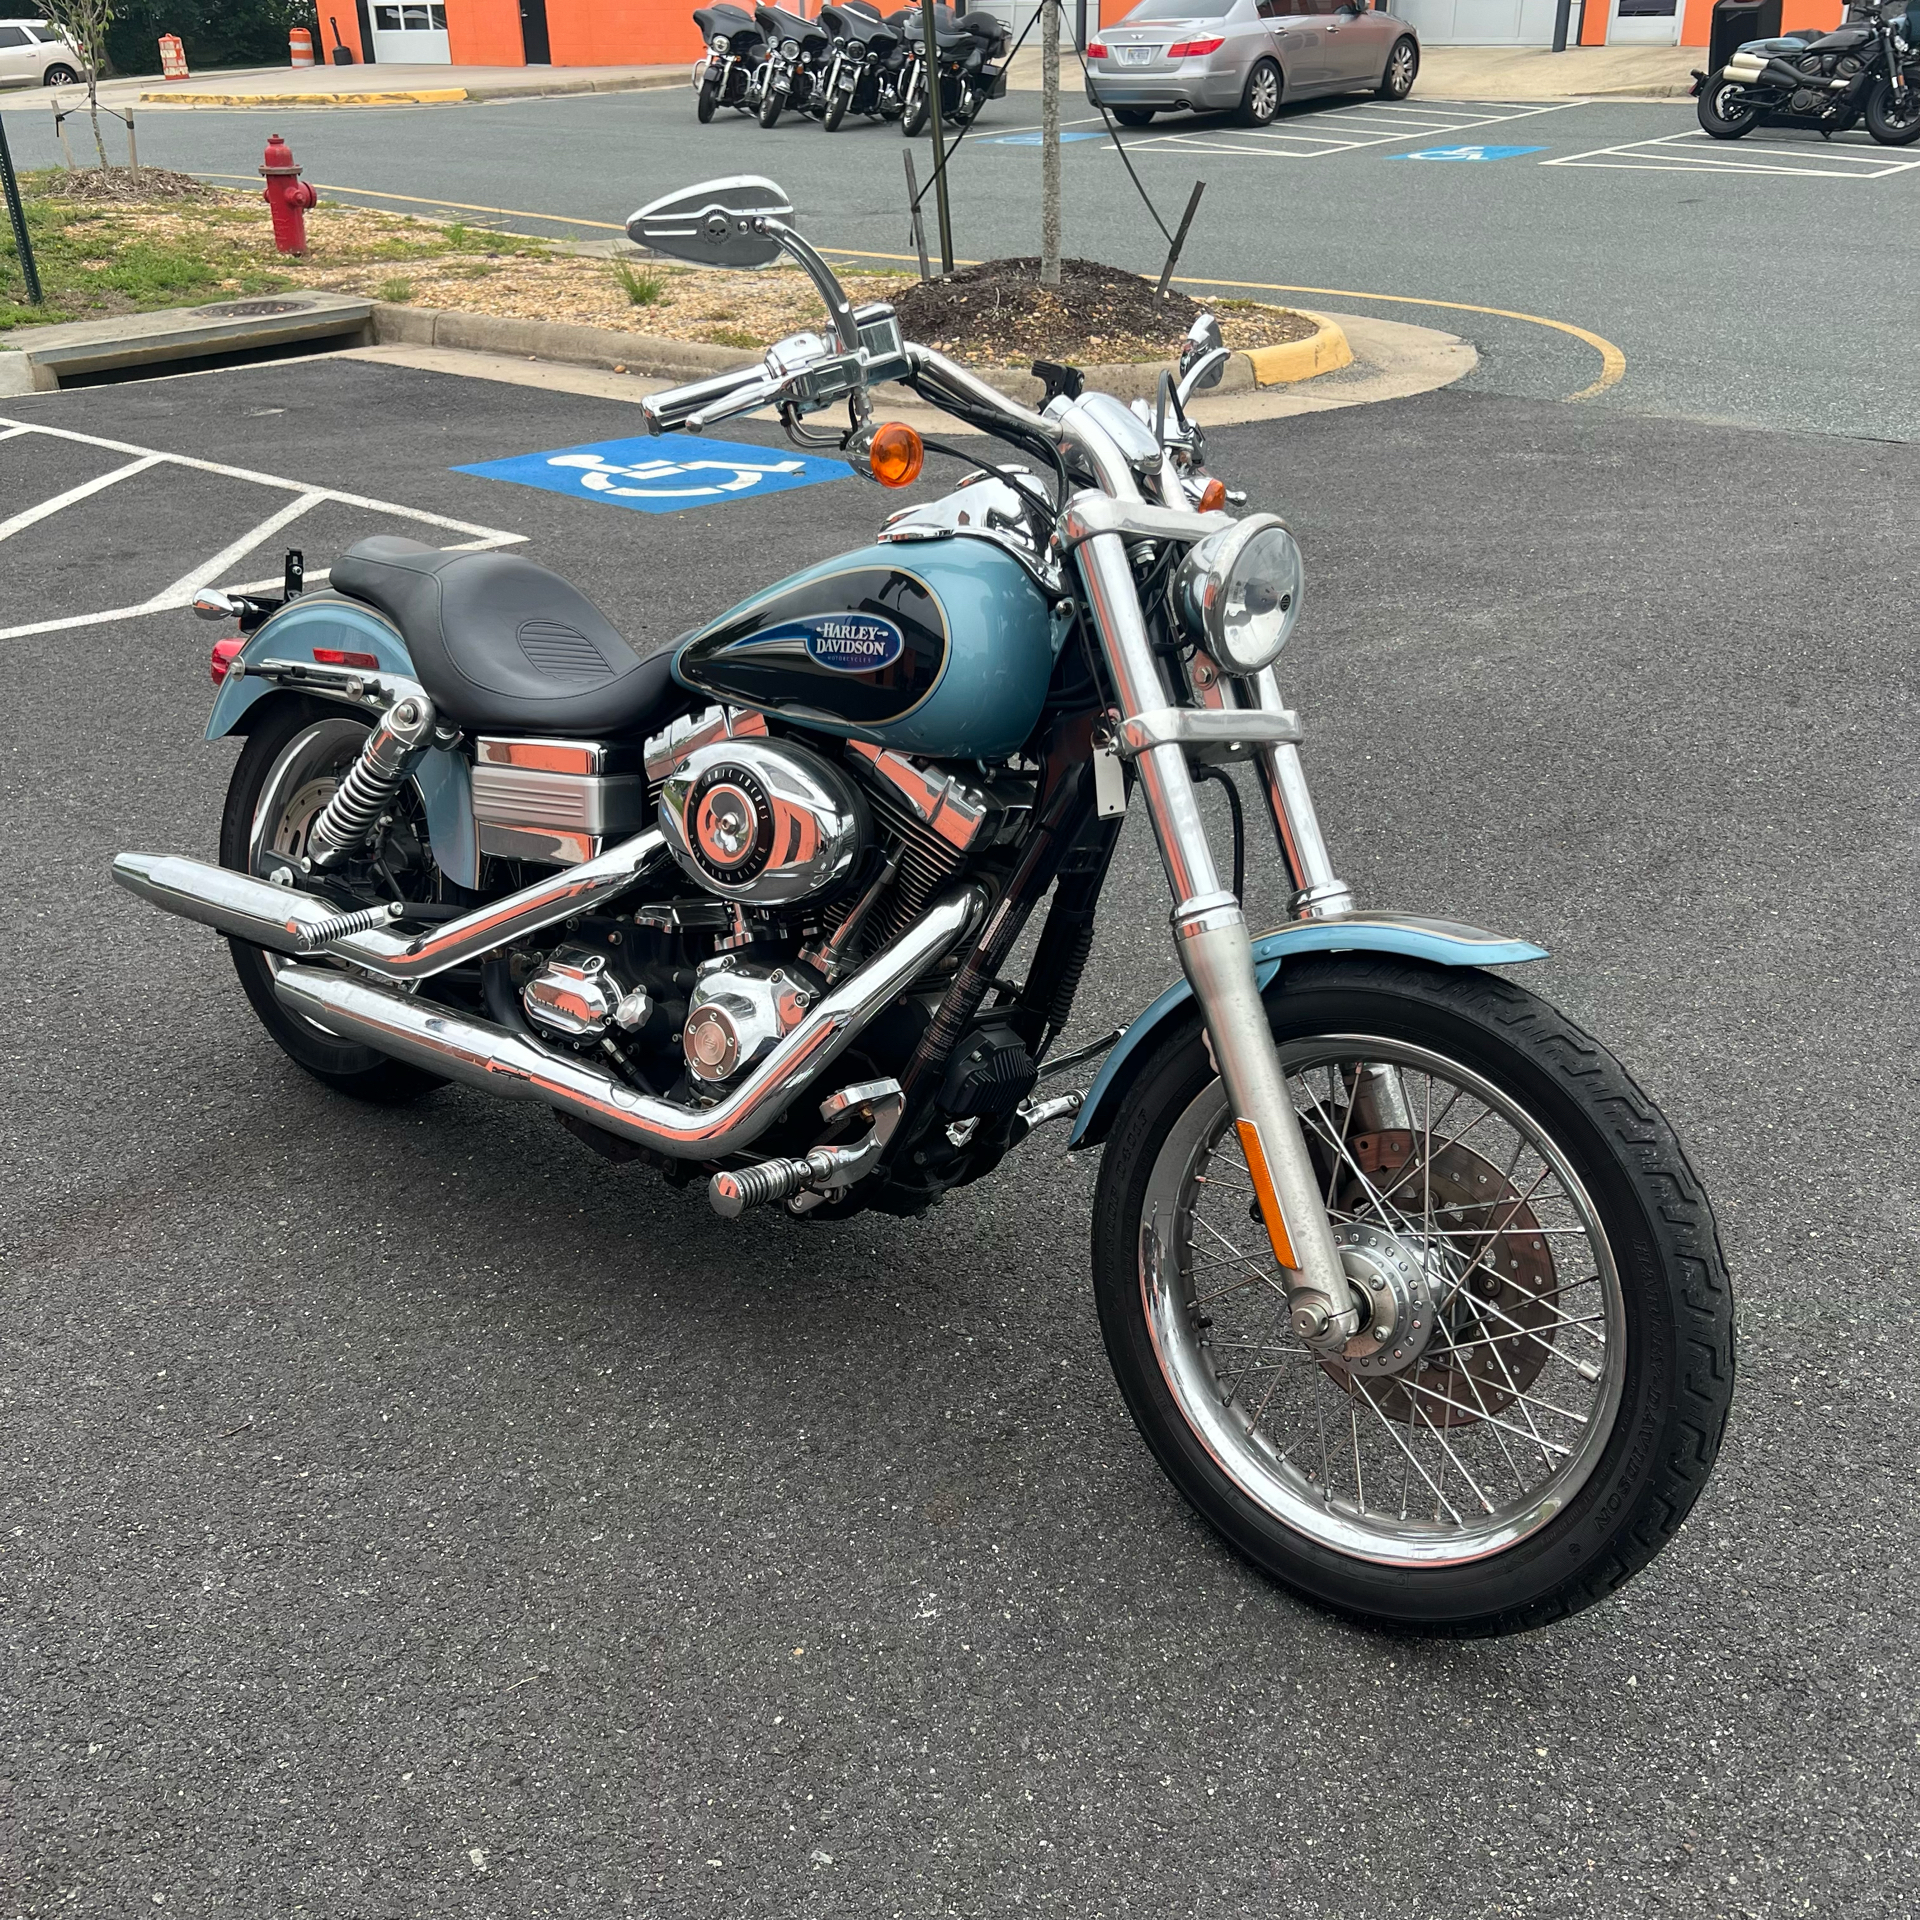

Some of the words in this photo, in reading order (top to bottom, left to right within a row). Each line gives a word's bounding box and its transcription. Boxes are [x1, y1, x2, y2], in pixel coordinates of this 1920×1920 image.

[822, 622, 880, 640] HARLEY
[815, 638, 886, 656] DAVIDSON
[827, 655, 872, 664] MOTORCYCLES
